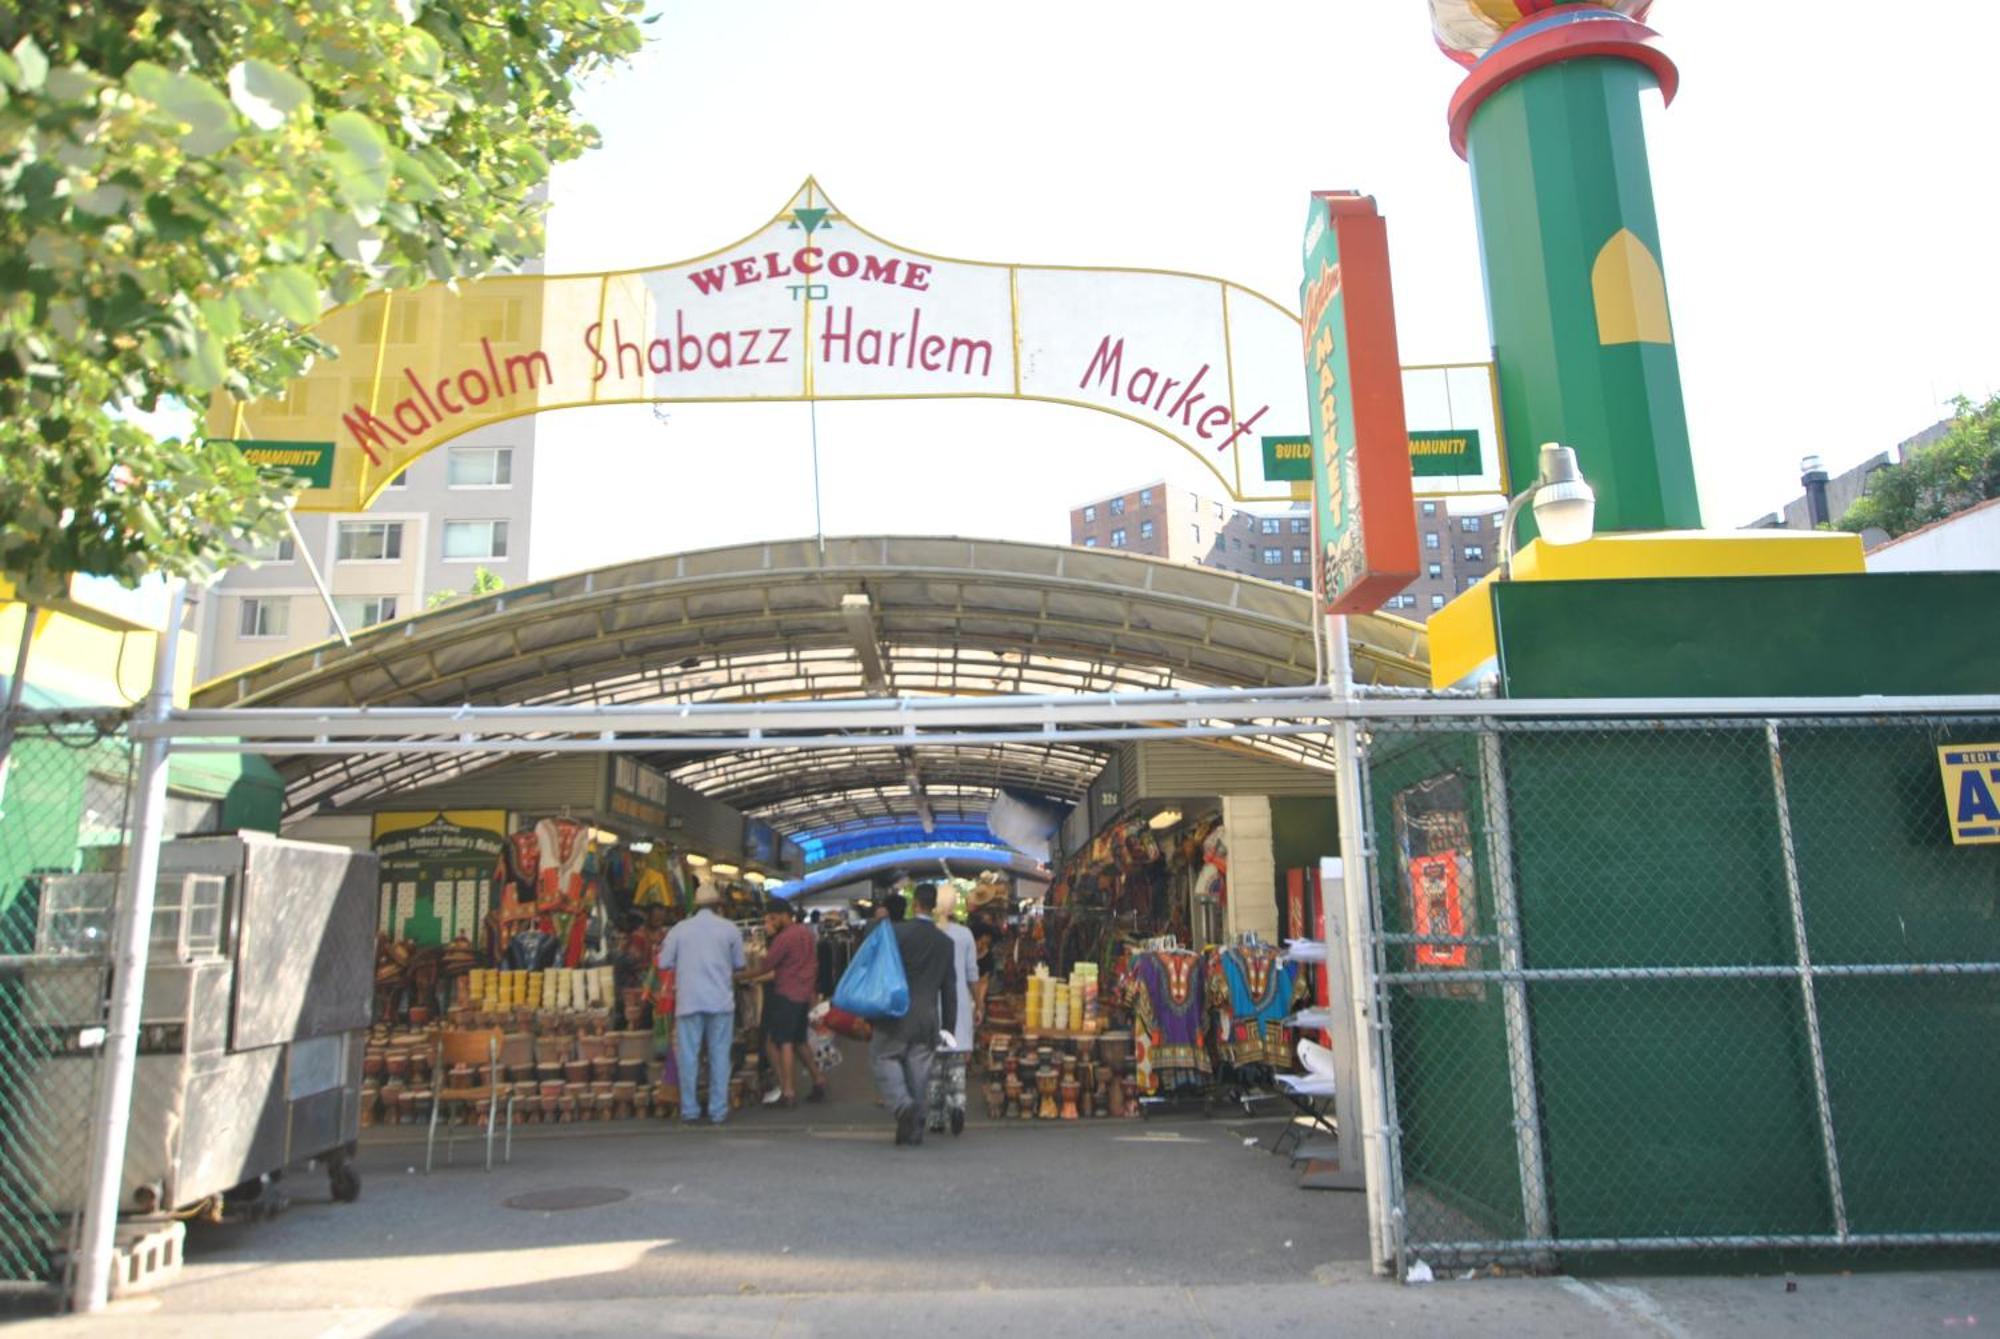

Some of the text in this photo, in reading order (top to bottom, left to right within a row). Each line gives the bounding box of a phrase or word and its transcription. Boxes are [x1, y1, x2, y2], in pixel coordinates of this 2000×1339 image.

[687, 246, 932, 295] WELCOME
[785, 284, 828, 301] TO
[342, 305, 1270, 467] Malcolm Shabazz Harlem Market
[1316, 325, 1341, 528] MARKET
[1408, 438, 1467, 455] MMUNITY
[1957, 769, 2000, 822] A
